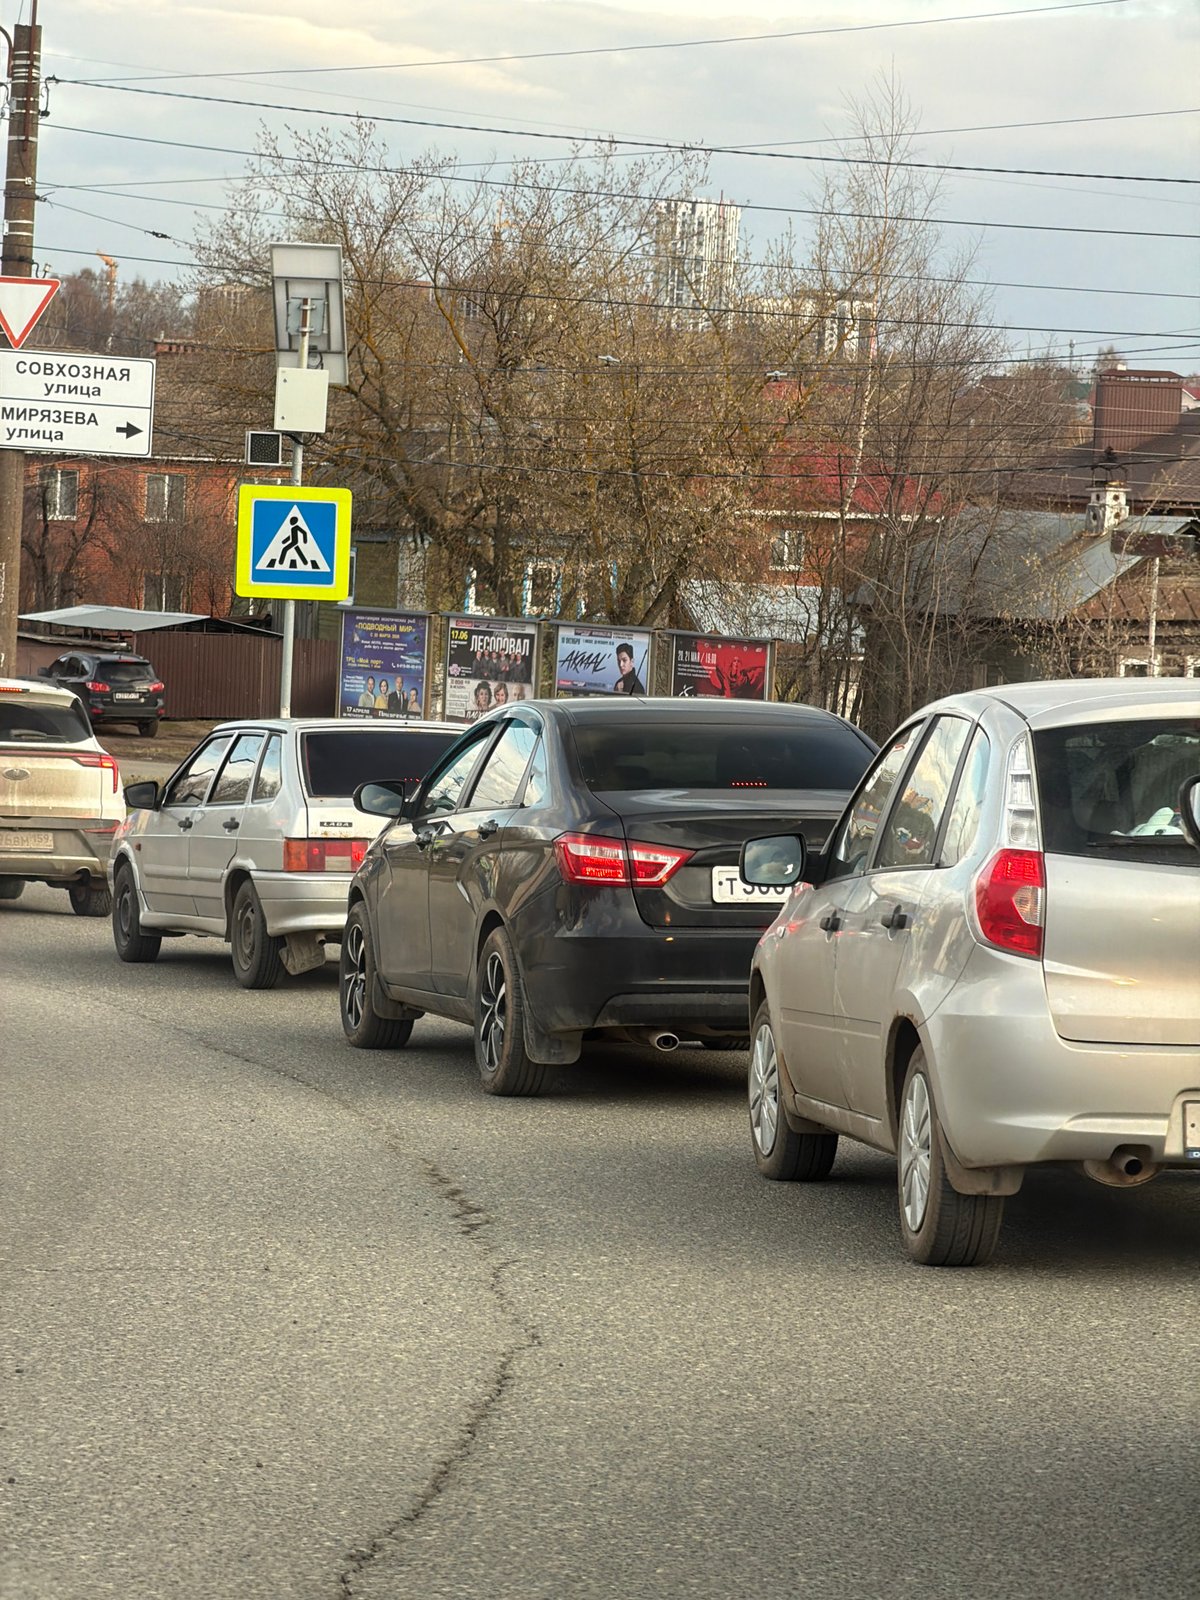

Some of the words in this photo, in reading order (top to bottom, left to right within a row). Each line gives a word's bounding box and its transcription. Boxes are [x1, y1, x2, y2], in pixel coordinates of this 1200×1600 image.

[16, 361, 130, 382] СОВХОЗНАЯ
[44, 382, 101, 398] улица
[1, 407, 98, 426] МИРЯЗЕВА
[6, 428, 64, 442] улица
[451, 630, 468, 640] 17.06
[470, 635, 530, 656] ЛЕСОПОВАЛ
